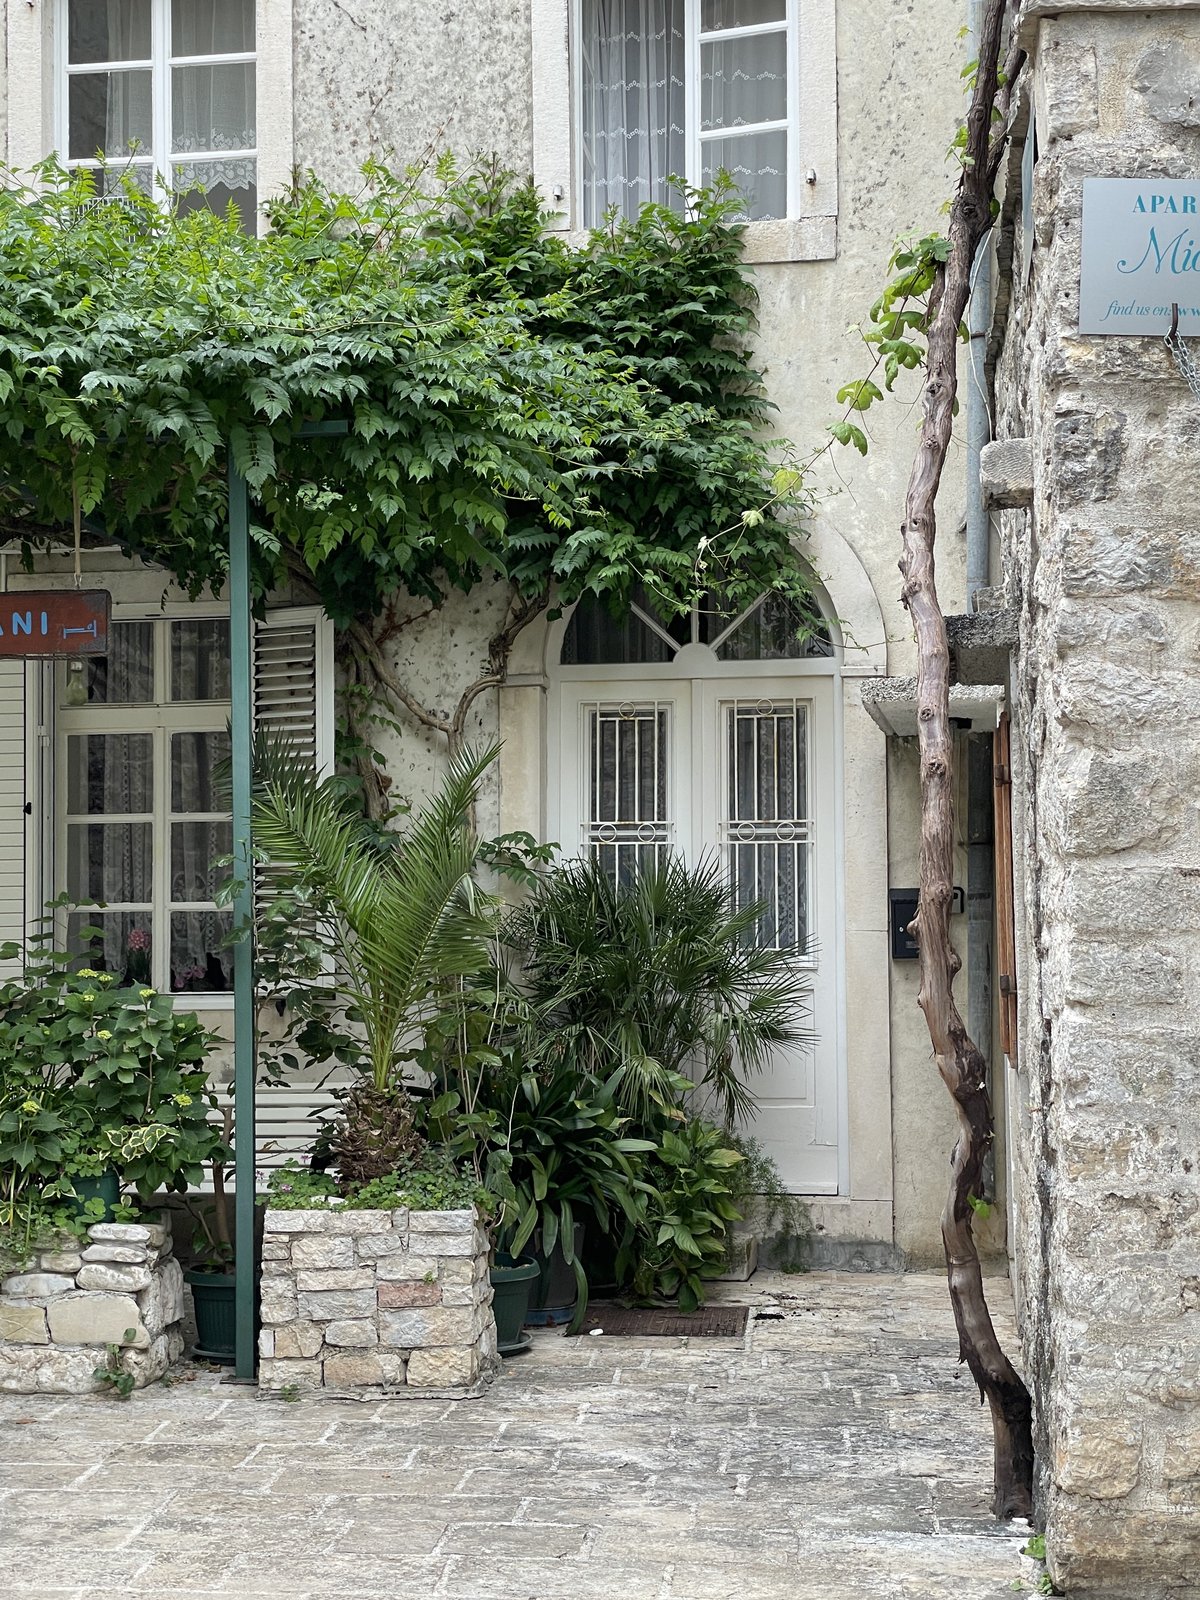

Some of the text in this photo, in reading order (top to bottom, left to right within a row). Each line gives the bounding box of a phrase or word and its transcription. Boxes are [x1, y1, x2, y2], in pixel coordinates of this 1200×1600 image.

[1132, 194, 1198, 214] APAR
[1099, 299, 1136, 322] find
[1136, 306, 1151, 317] us
[0, 611, 48, 636] NI
